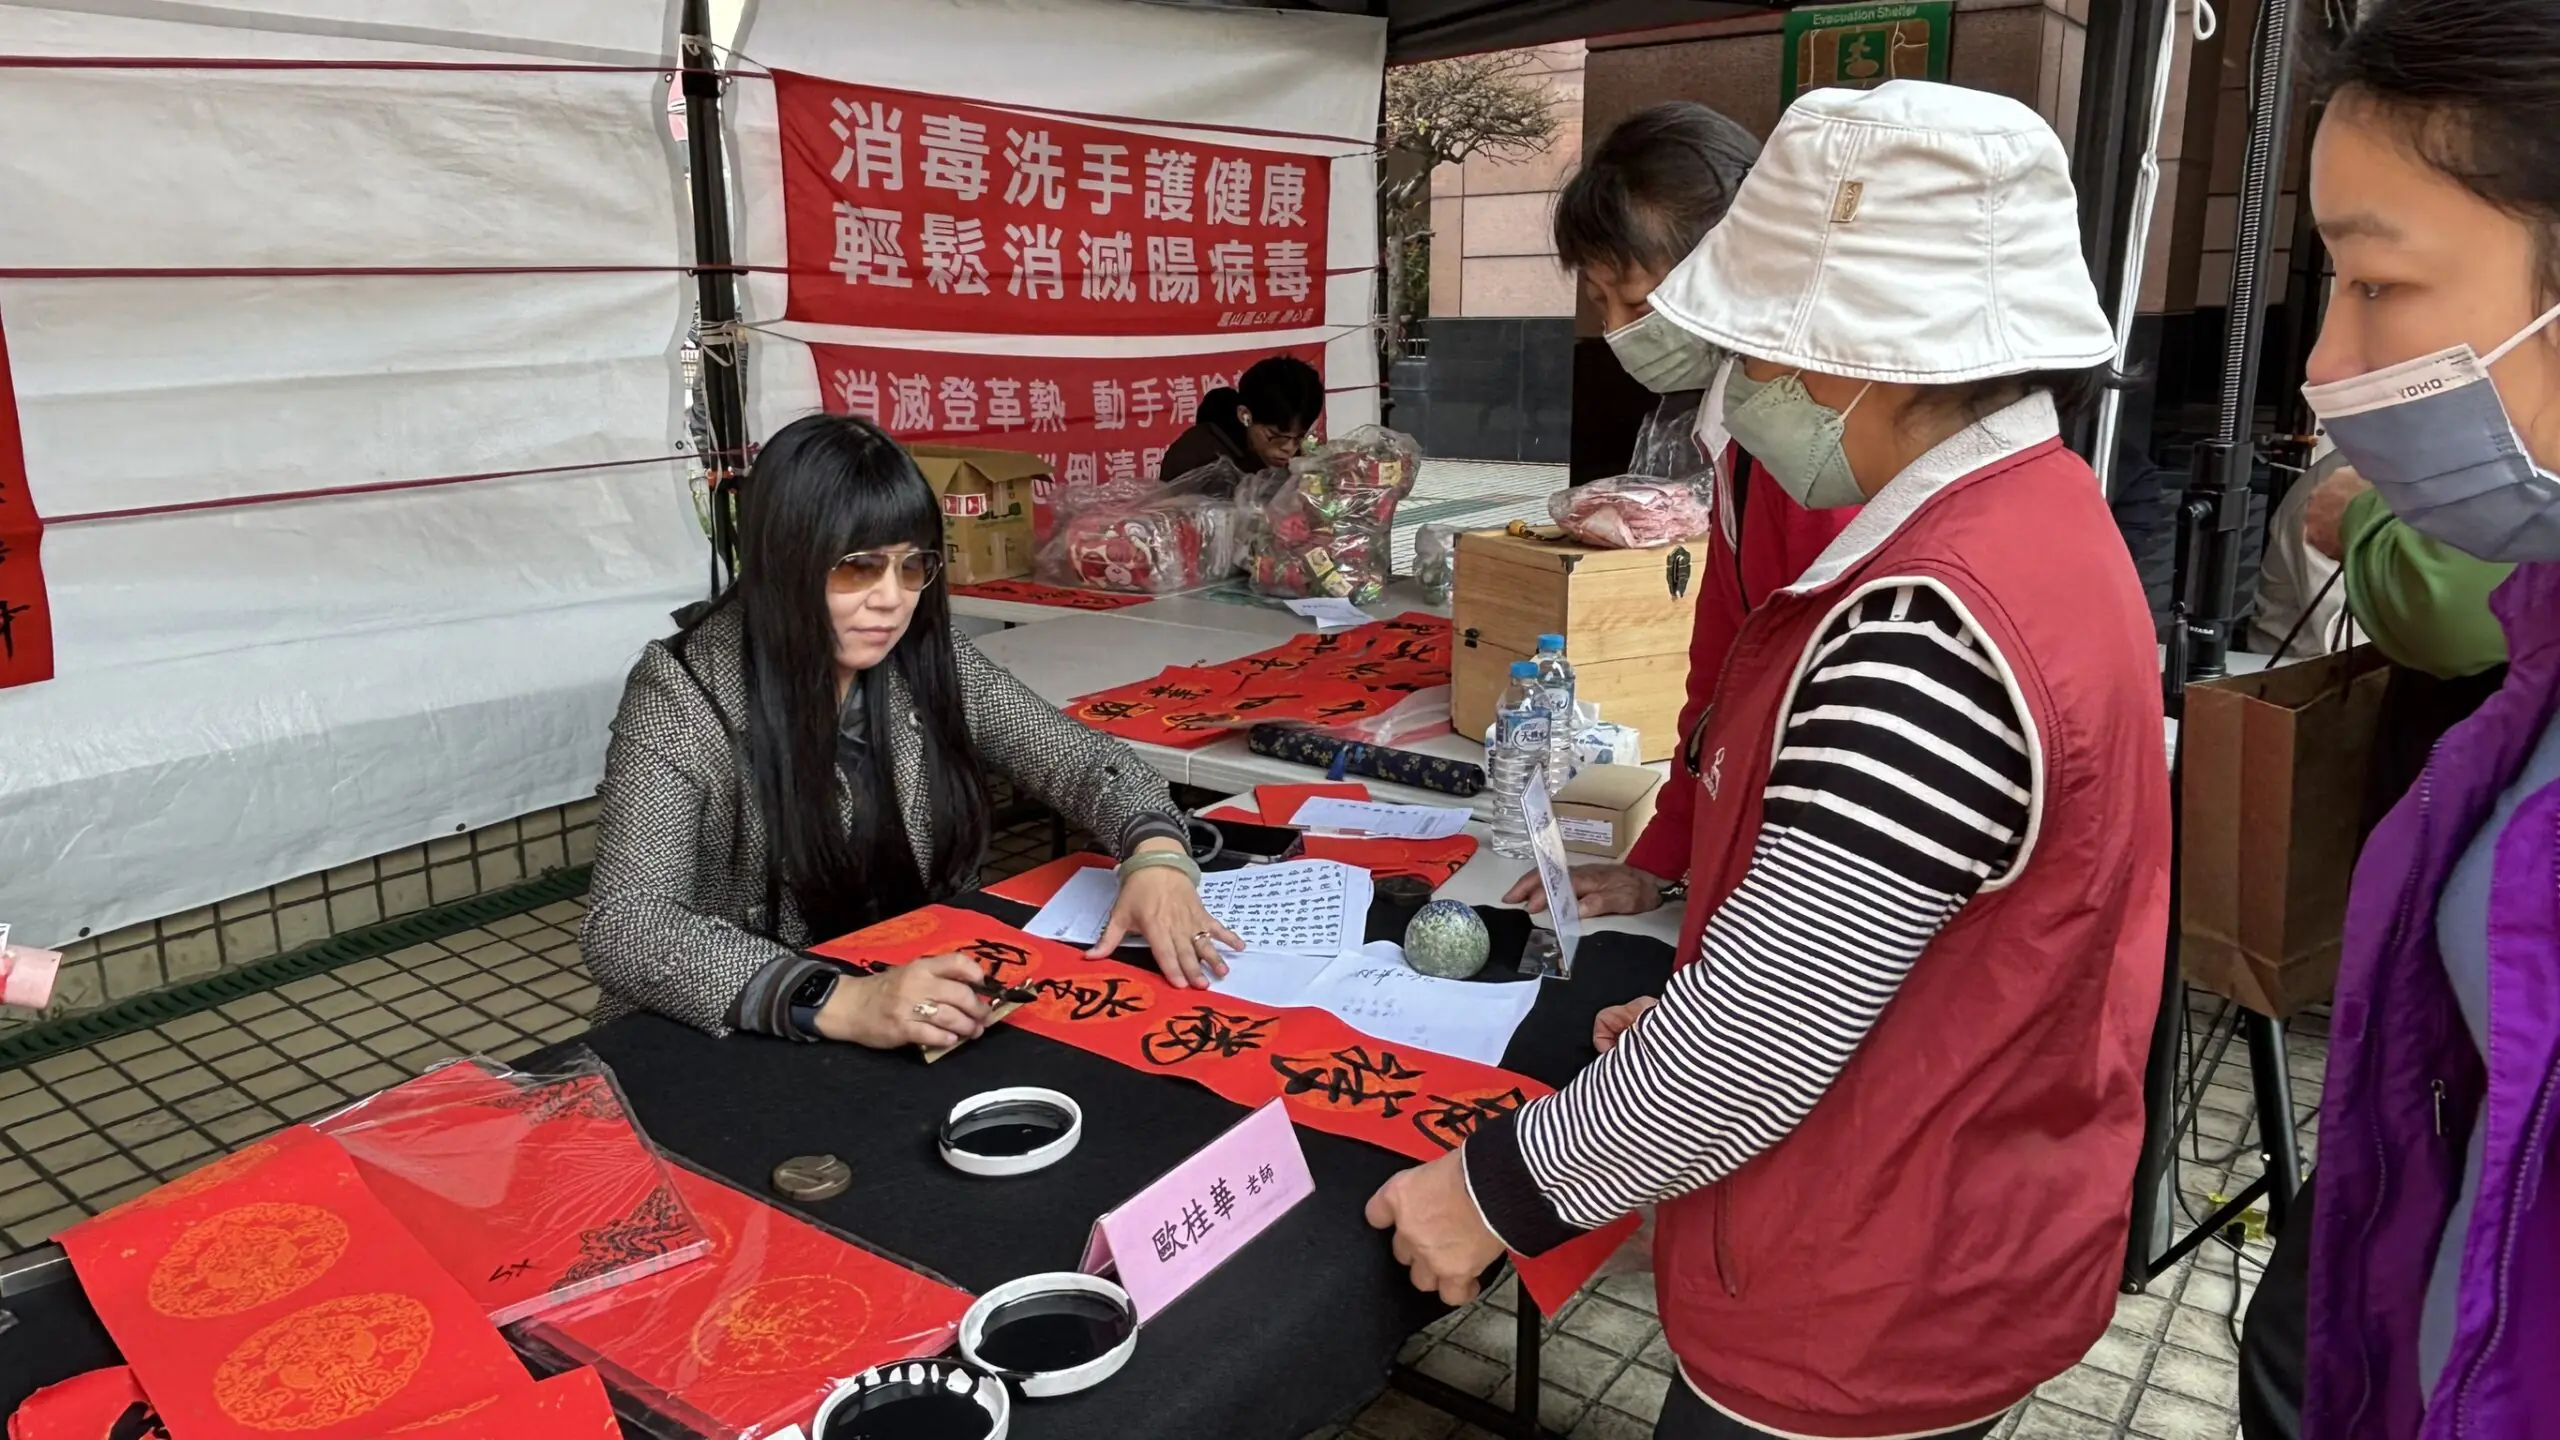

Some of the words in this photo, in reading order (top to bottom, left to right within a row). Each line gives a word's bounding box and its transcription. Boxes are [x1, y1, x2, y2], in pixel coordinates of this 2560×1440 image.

[1812, 9, 1876, 25] Evacuation
[1878, 5, 1919, 19] Shelter
[828, 97, 1307, 228] 消毒洗手護健康
[828, 200, 1313, 306] 輕鬆消滅腸病毒
[833, 368, 1067, 433] 消滅登革熱
[1152, 1177, 1236, 1263] 歐桂華
[1245, 1162, 1275, 1197] 老師
